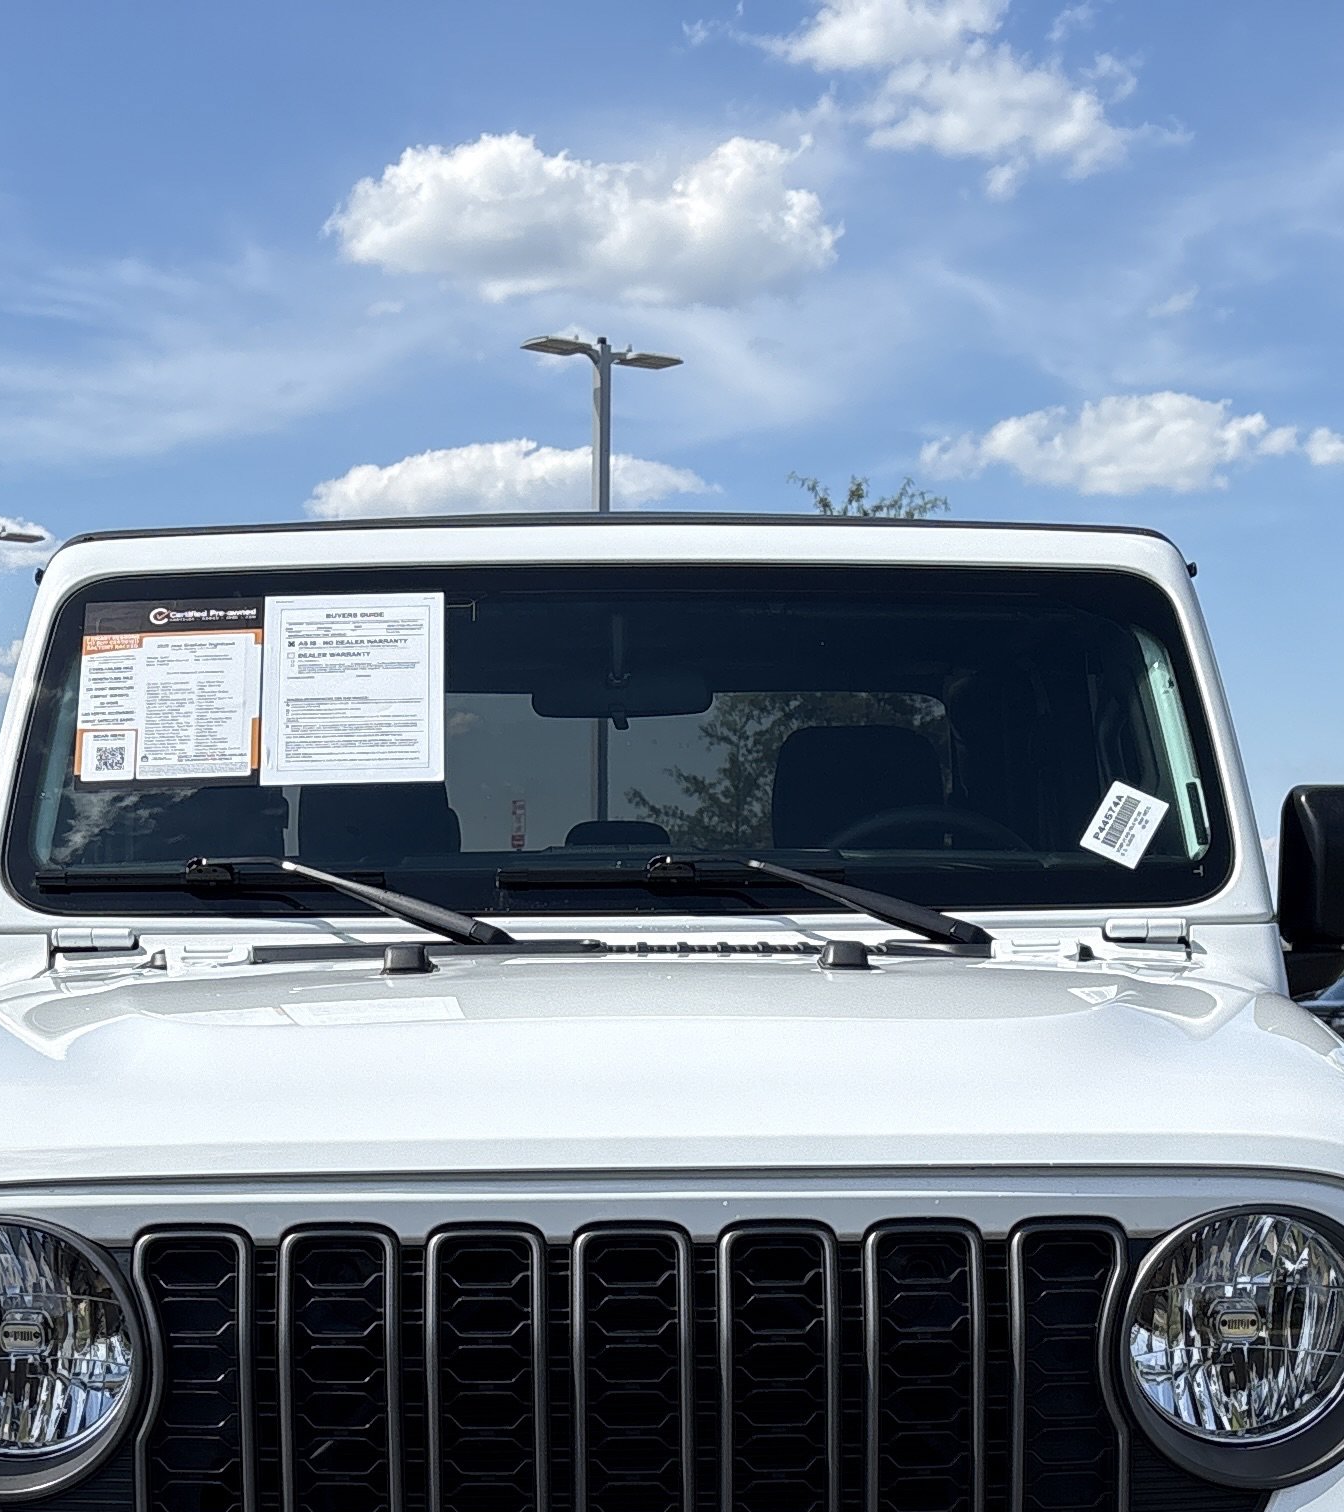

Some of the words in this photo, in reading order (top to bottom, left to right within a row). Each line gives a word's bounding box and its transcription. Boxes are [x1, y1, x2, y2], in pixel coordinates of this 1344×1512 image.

[169, 609, 208, 618] Certified
[366, 638, 409, 646] WARRANTY
[1092, 794, 1125, 841] P44574A
